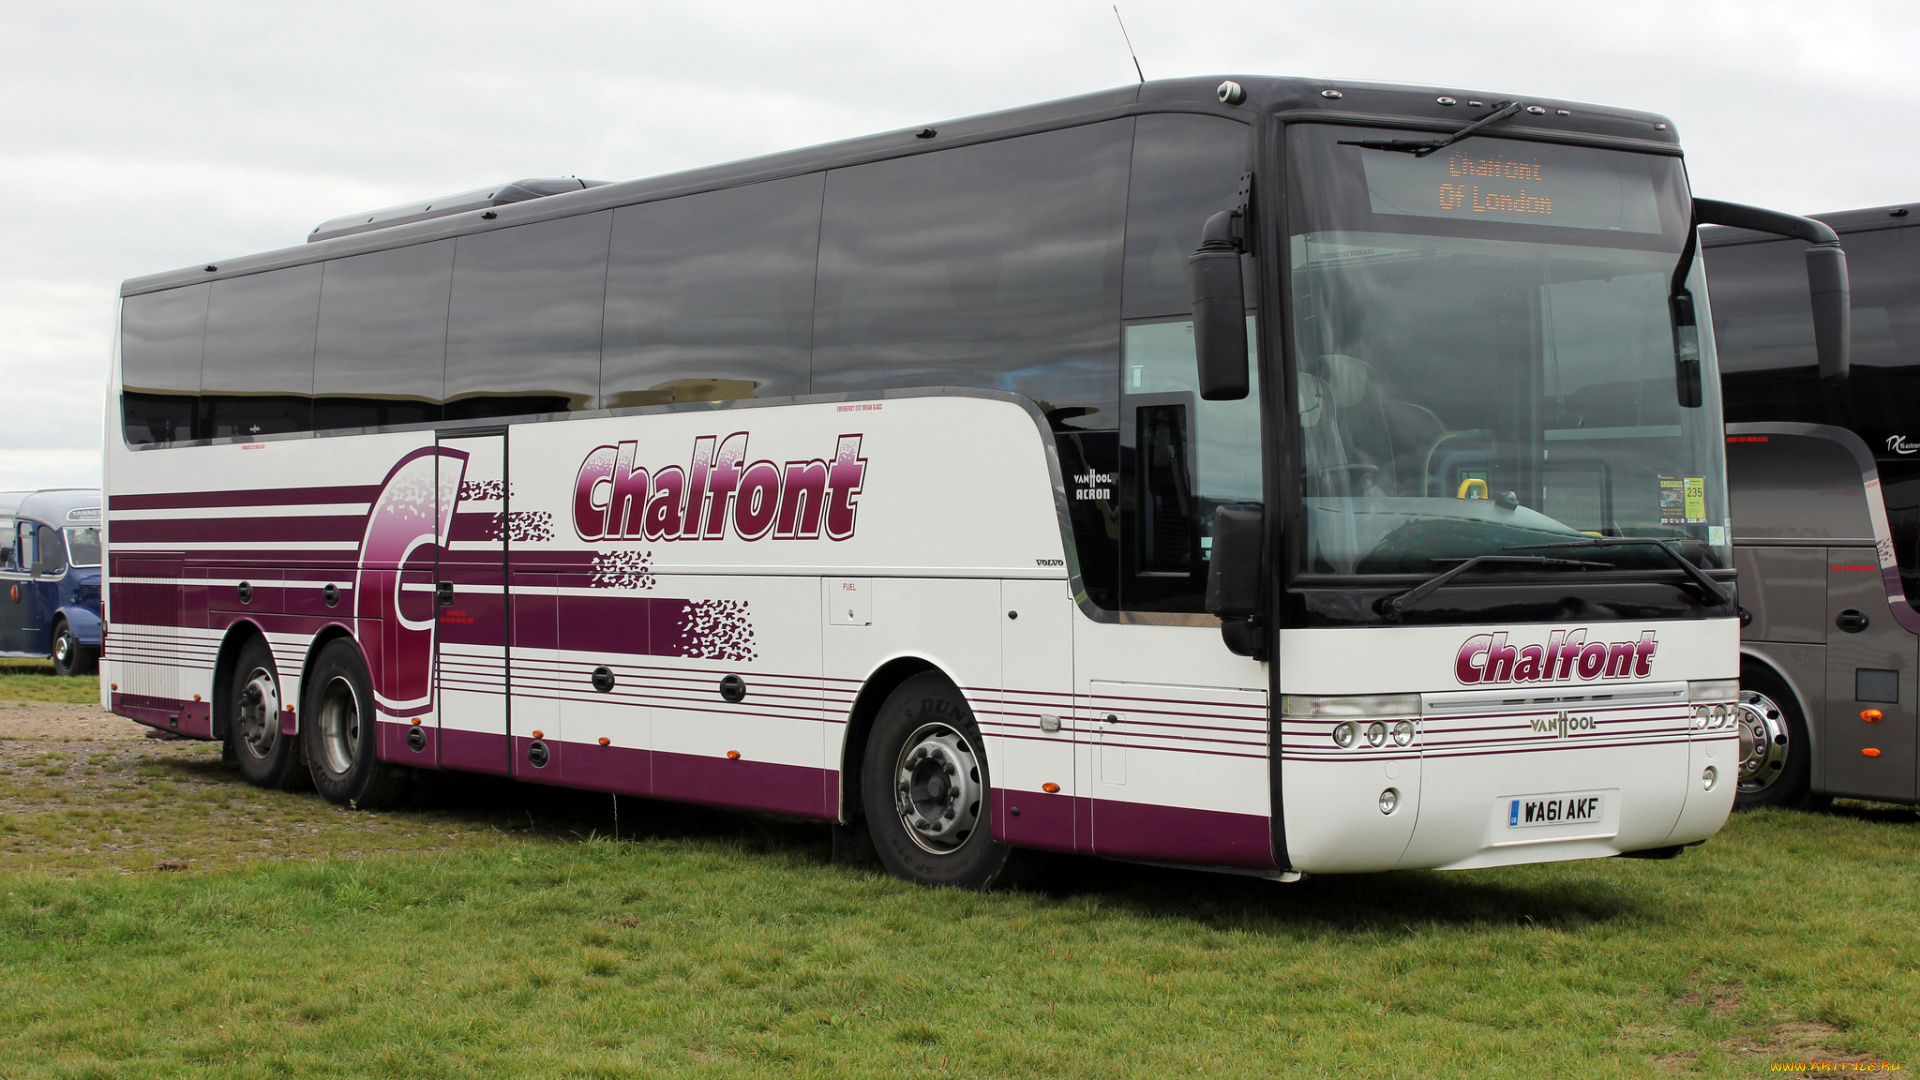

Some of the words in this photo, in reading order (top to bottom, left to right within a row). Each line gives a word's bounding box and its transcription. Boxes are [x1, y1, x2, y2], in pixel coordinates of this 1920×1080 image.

[1450, 152, 1542, 181] Chalfont
[1440, 183, 1465, 210] Of
[1473, 186, 1552, 214] London
[572, 431, 868, 542] Chalfont
[1076, 488, 1110, 500] ACRON
[1687, 488, 1702, 497] 235
[843, 583, 856, 591] FUEL
[1454, 628, 1659, 686] Chalfont
[1525, 800, 1562, 823] WA61
[1566, 797, 1599, 820] AKF
